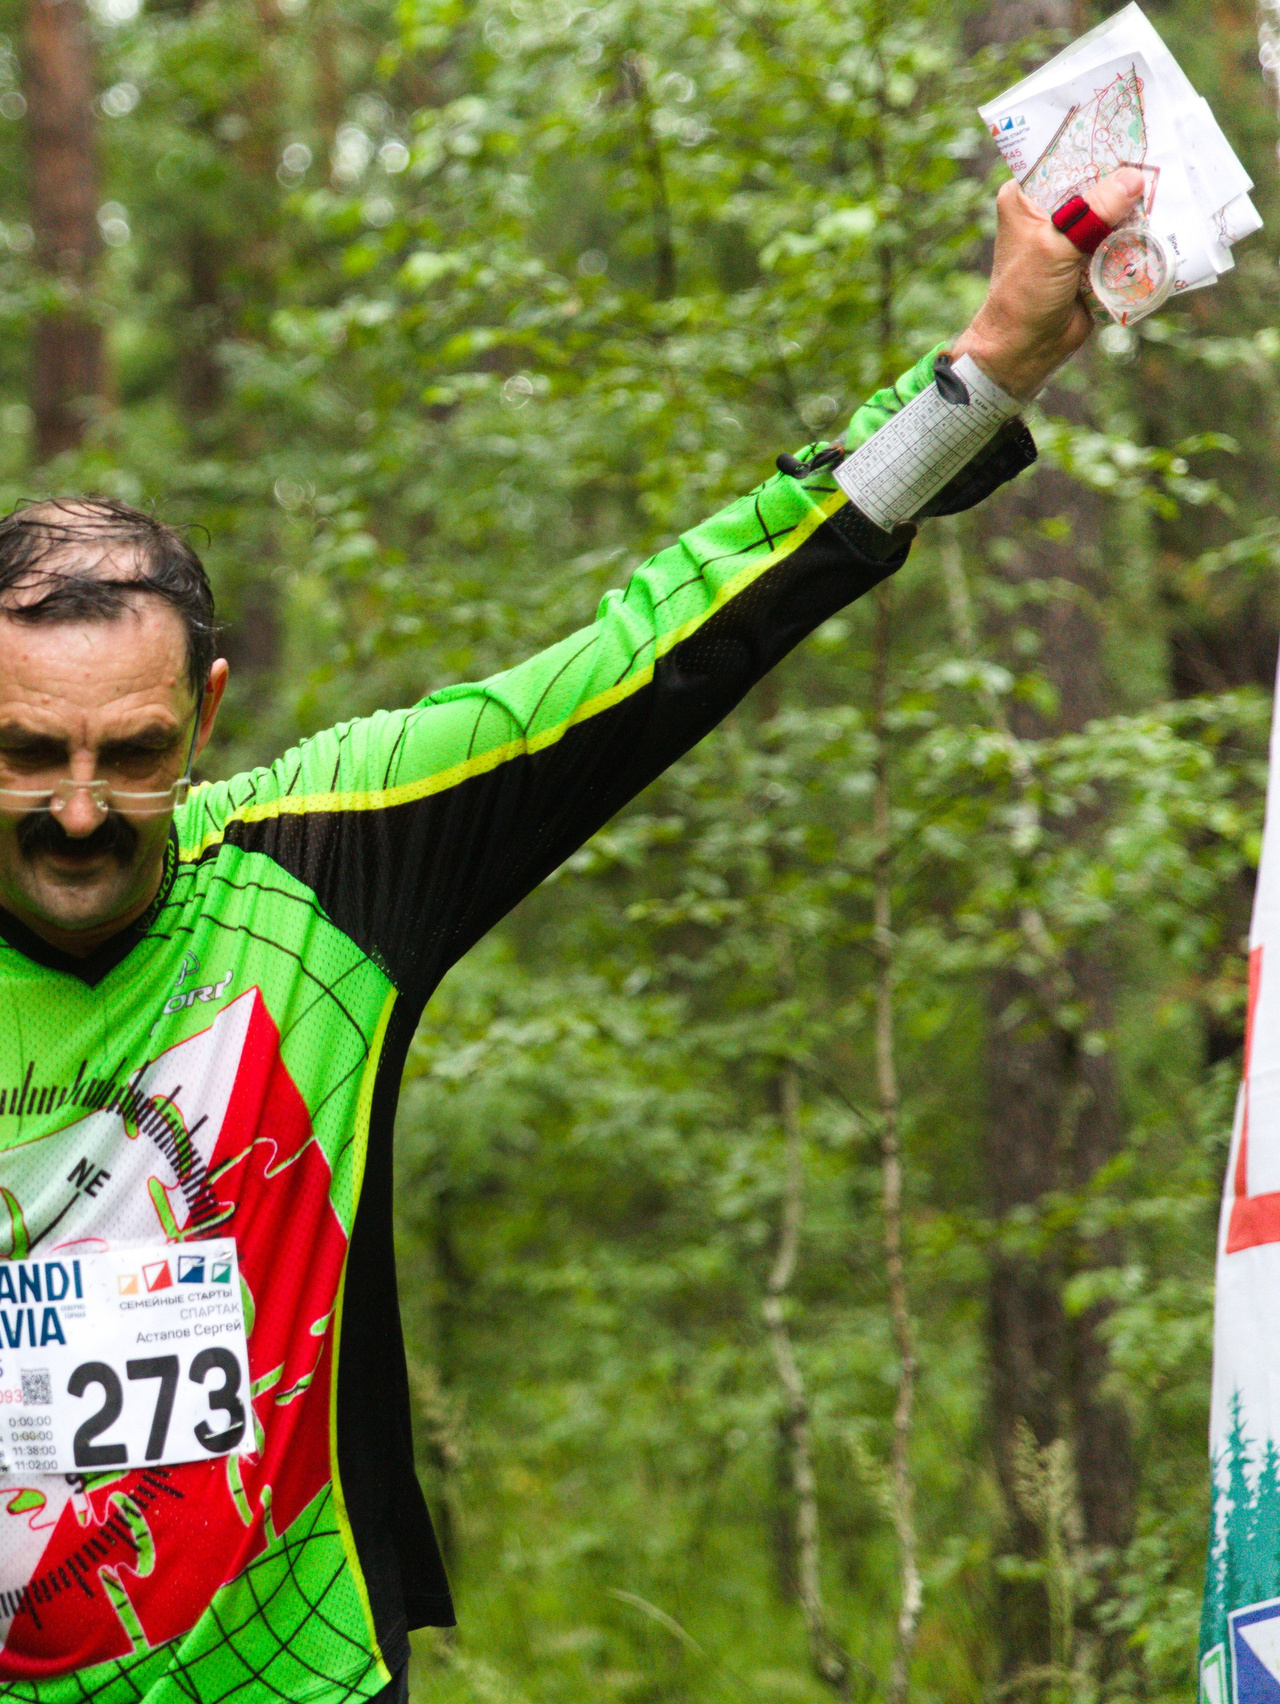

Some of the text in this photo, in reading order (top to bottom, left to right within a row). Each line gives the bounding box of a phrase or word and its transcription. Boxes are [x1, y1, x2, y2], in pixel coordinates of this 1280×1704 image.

[66, 1155, 111, 1198] NE
[119, 1289, 233, 1311] СЕМЕЙНЫЕ СТАРТЫ
[180, 1302, 240, 1320] СПАРТАК
[136, 1318, 242, 1344] Астапов Сергей
[67, 1347, 247, 1468] 273
[9, 1415, 52, 1427] 0:00:00
[13, 1445, 56, 1456] 11:38:00
[15, 1460, 58, 1470] 11:02:00
